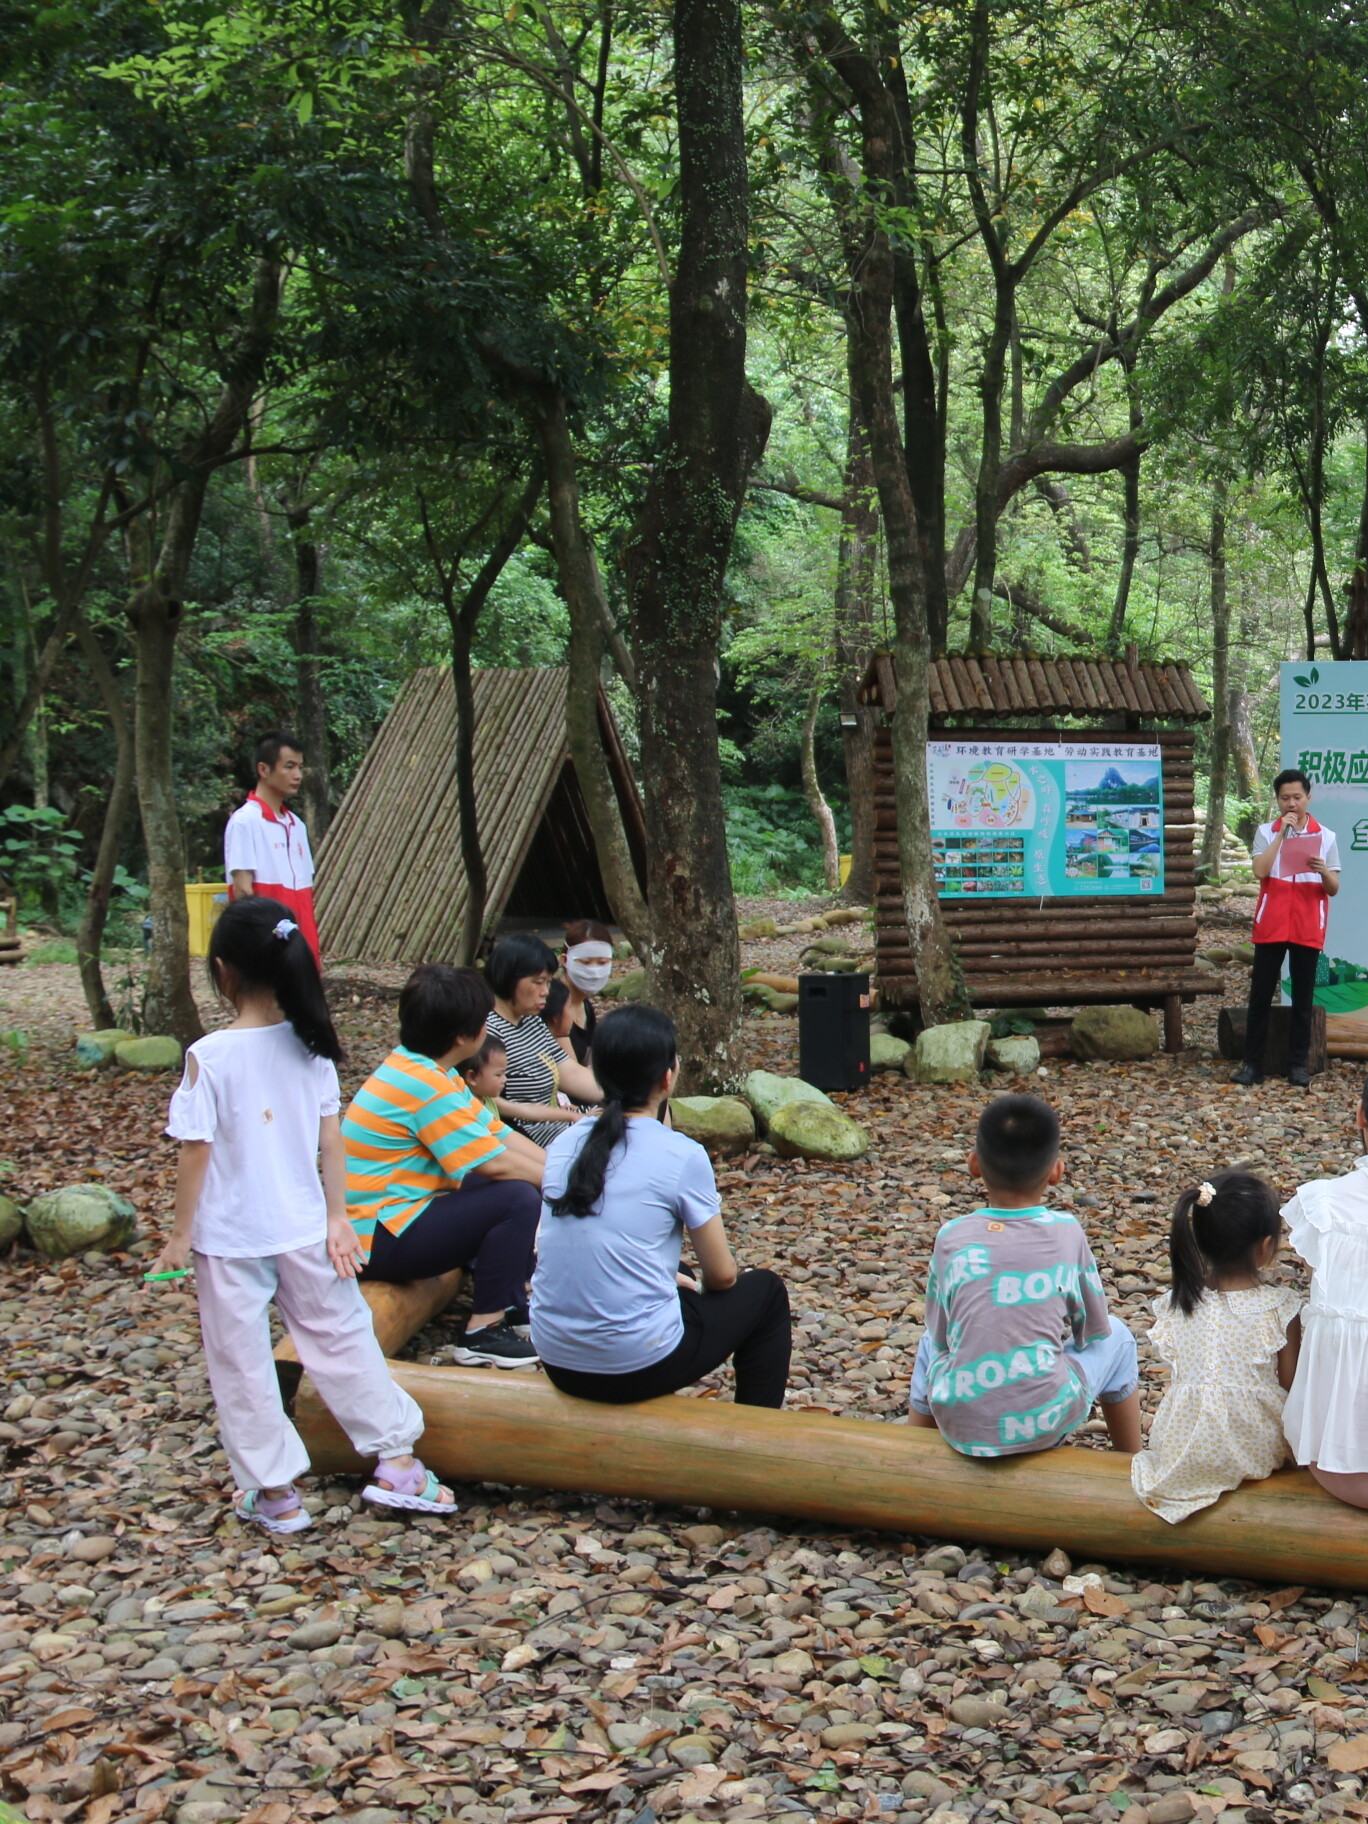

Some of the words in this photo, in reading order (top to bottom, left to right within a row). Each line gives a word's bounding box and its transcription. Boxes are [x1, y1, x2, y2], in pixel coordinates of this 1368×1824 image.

[956, 745, 1055, 756] 环境教育研学基地
